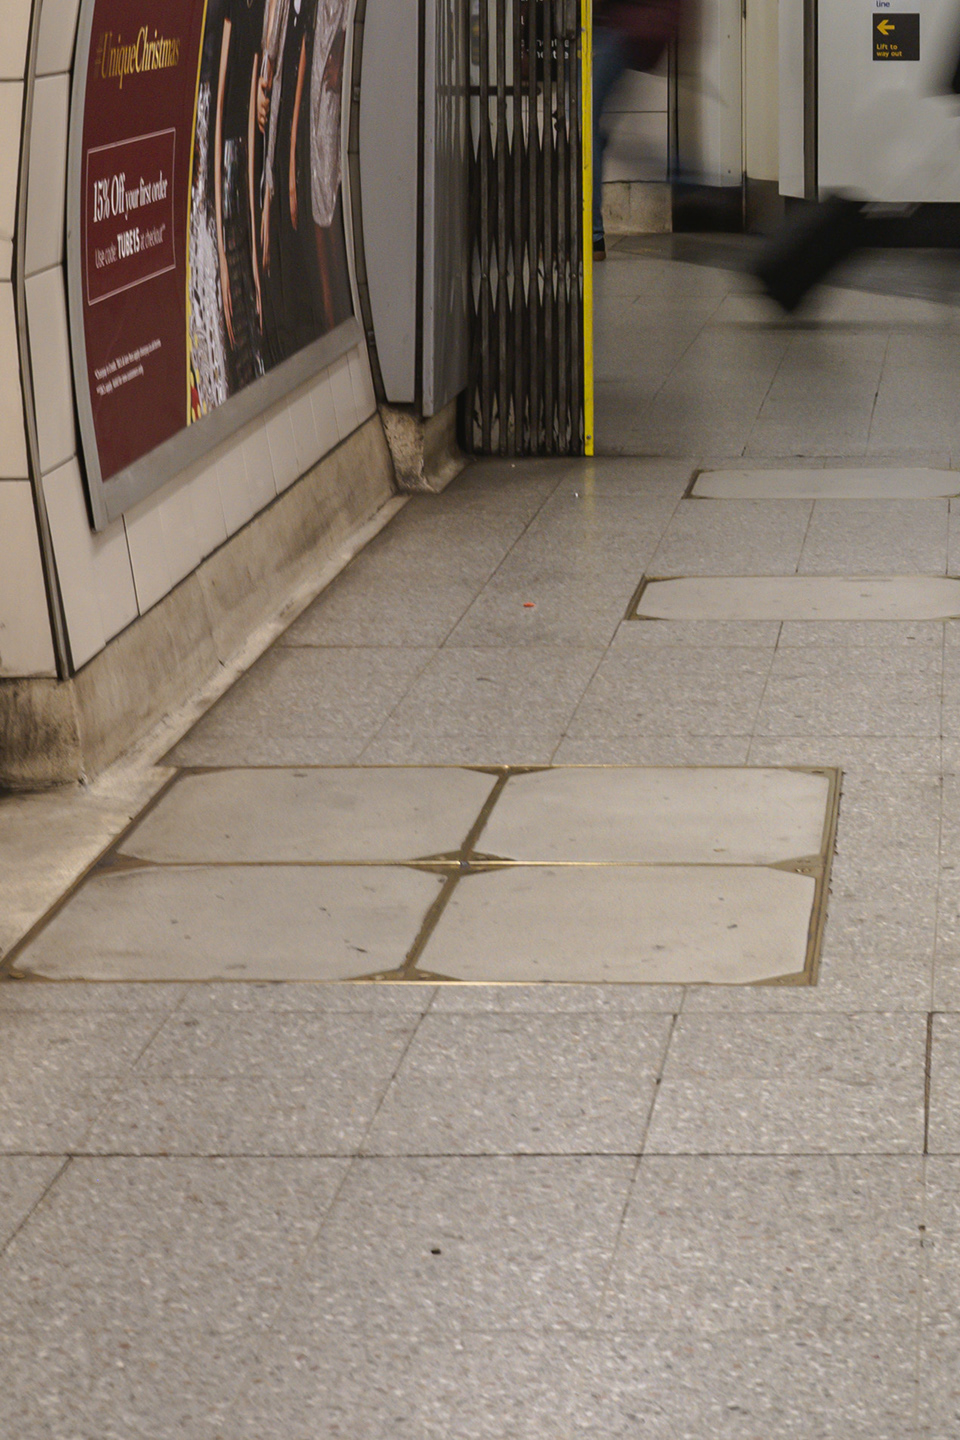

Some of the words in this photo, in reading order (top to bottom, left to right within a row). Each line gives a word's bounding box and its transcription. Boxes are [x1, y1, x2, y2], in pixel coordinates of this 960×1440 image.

[94, 178, 110, 222] 15%
[110, 172, 126, 216] Off
[125, 188, 140, 220] your
[140, 176, 152, 207] first
[152, 170, 168, 202] order
[117, 226, 140, 260] TUBE15
